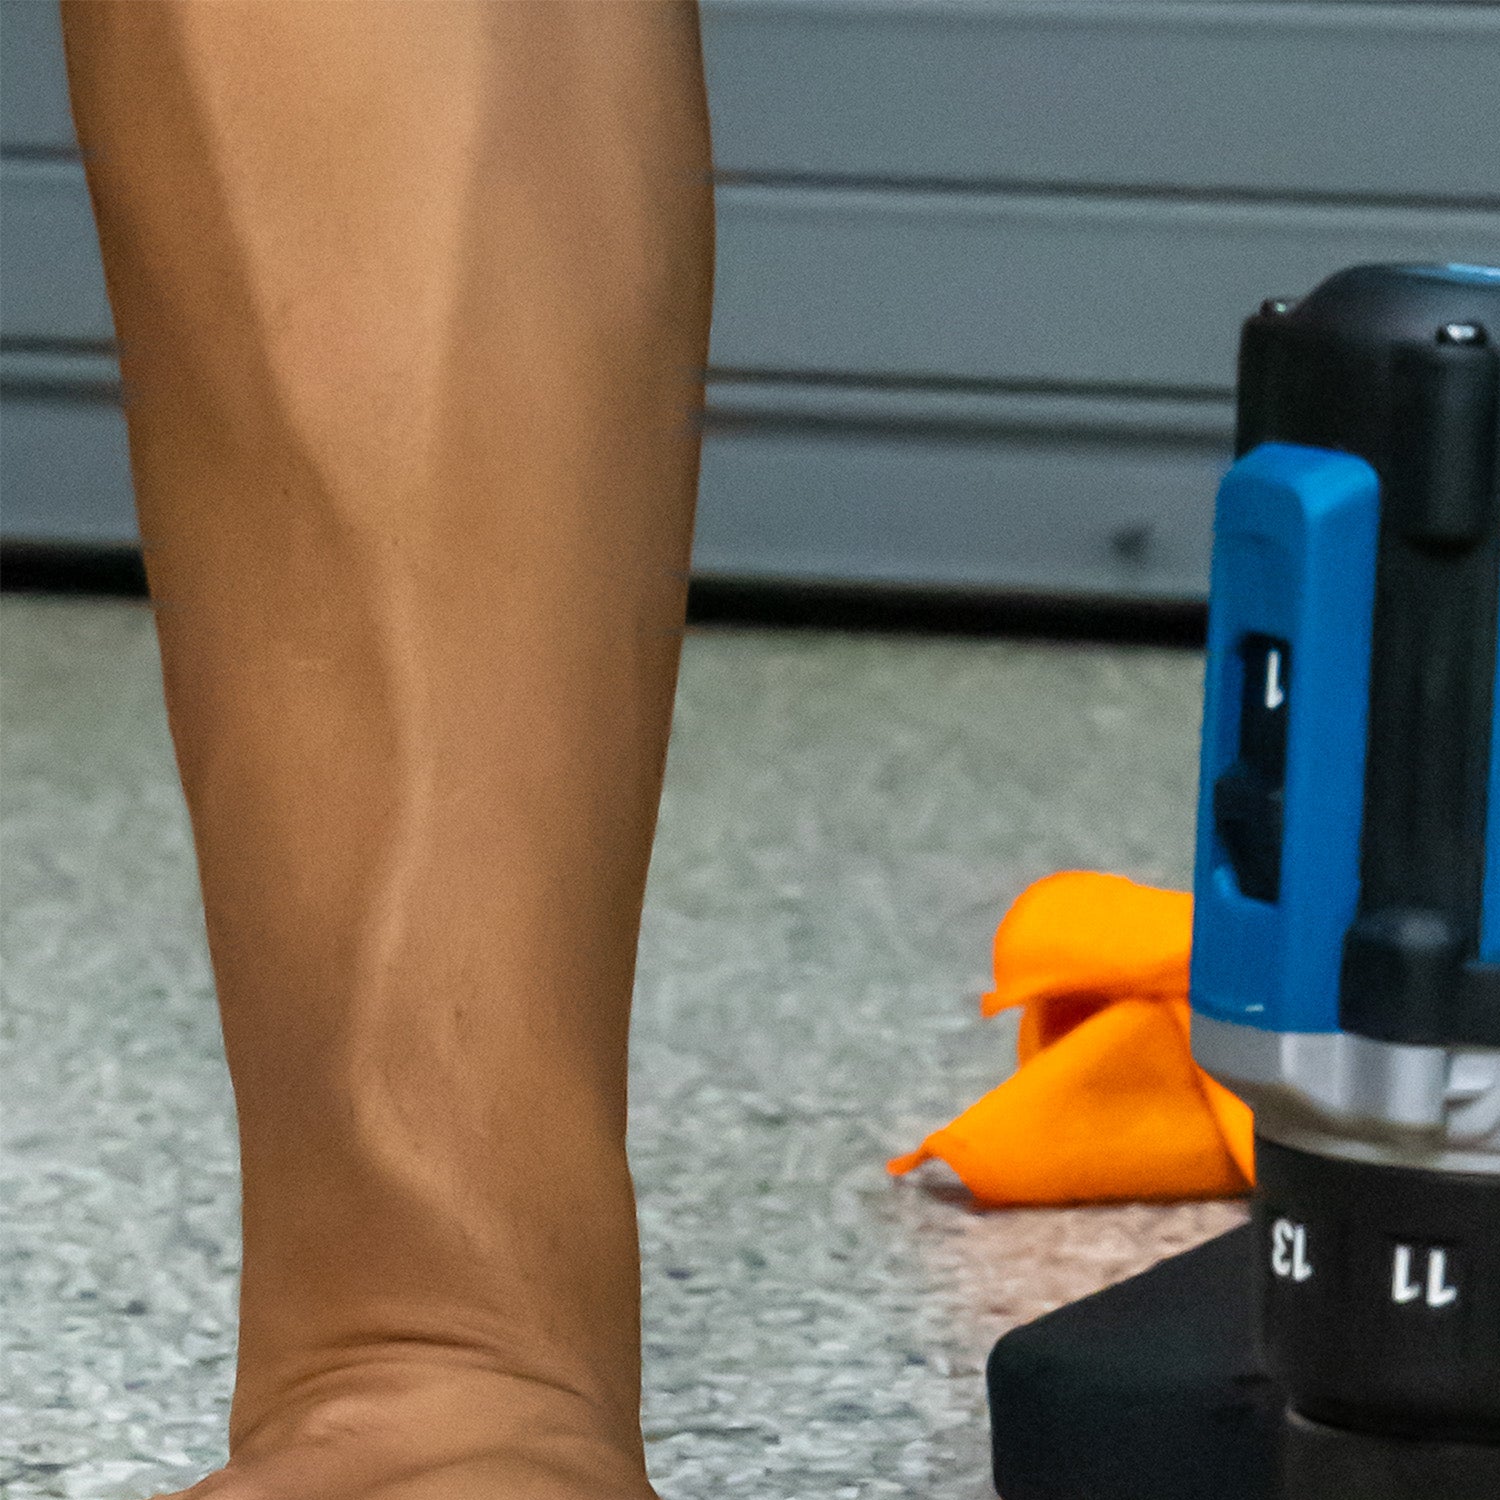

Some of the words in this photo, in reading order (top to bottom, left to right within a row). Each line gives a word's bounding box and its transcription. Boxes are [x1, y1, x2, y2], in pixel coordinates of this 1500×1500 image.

[1265, 651, 1284, 709] 1
[1271, 1218, 1313, 1282] 13
[1391, 1245, 1458, 1308] 11
